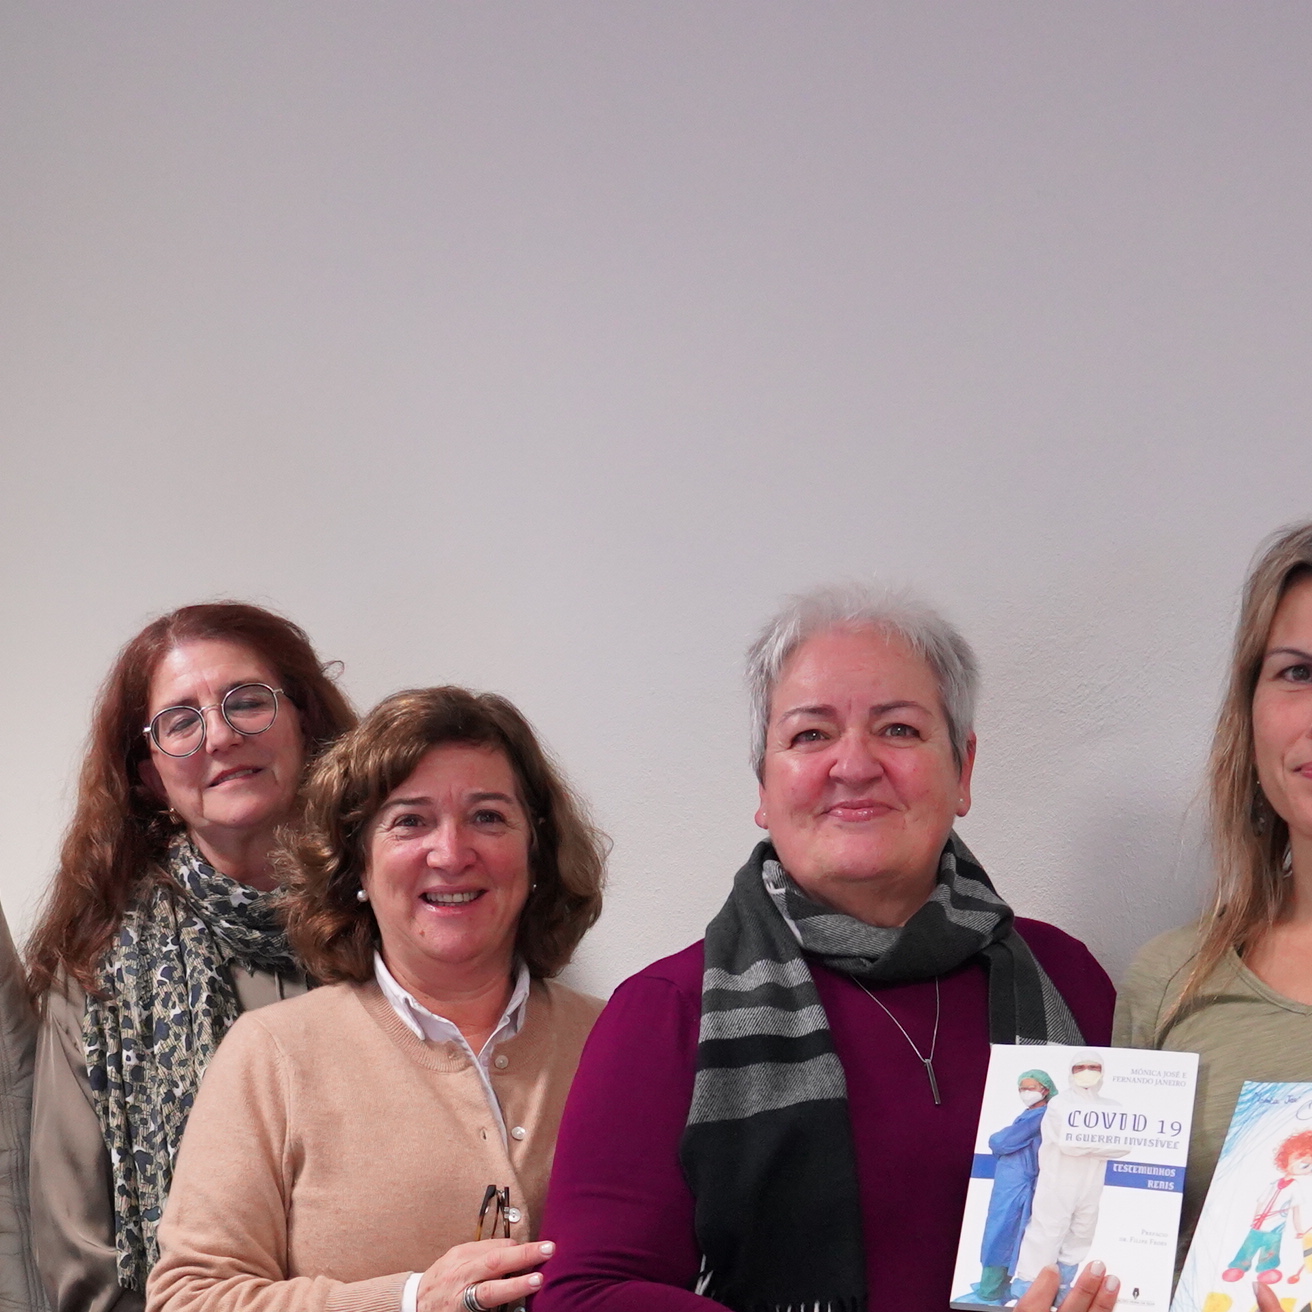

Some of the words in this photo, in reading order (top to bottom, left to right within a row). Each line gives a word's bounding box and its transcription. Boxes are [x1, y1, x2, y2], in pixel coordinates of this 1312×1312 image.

[1131, 1067, 1161, 1077] MÓNICA
[1112, 1076, 1153, 1085] FERNANDO
[1154, 1078, 1186, 1087] JANEIRO
[1068, 1110, 1147, 1132] COVID
[1157, 1119, 1182, 1137] 19
[1075, 1133, 1121, 1145] GUERRA
[1112, 1163, 1176, 1178] TESTEMUNHOS
[1147, 1179, 1175, 1190] REAIS
